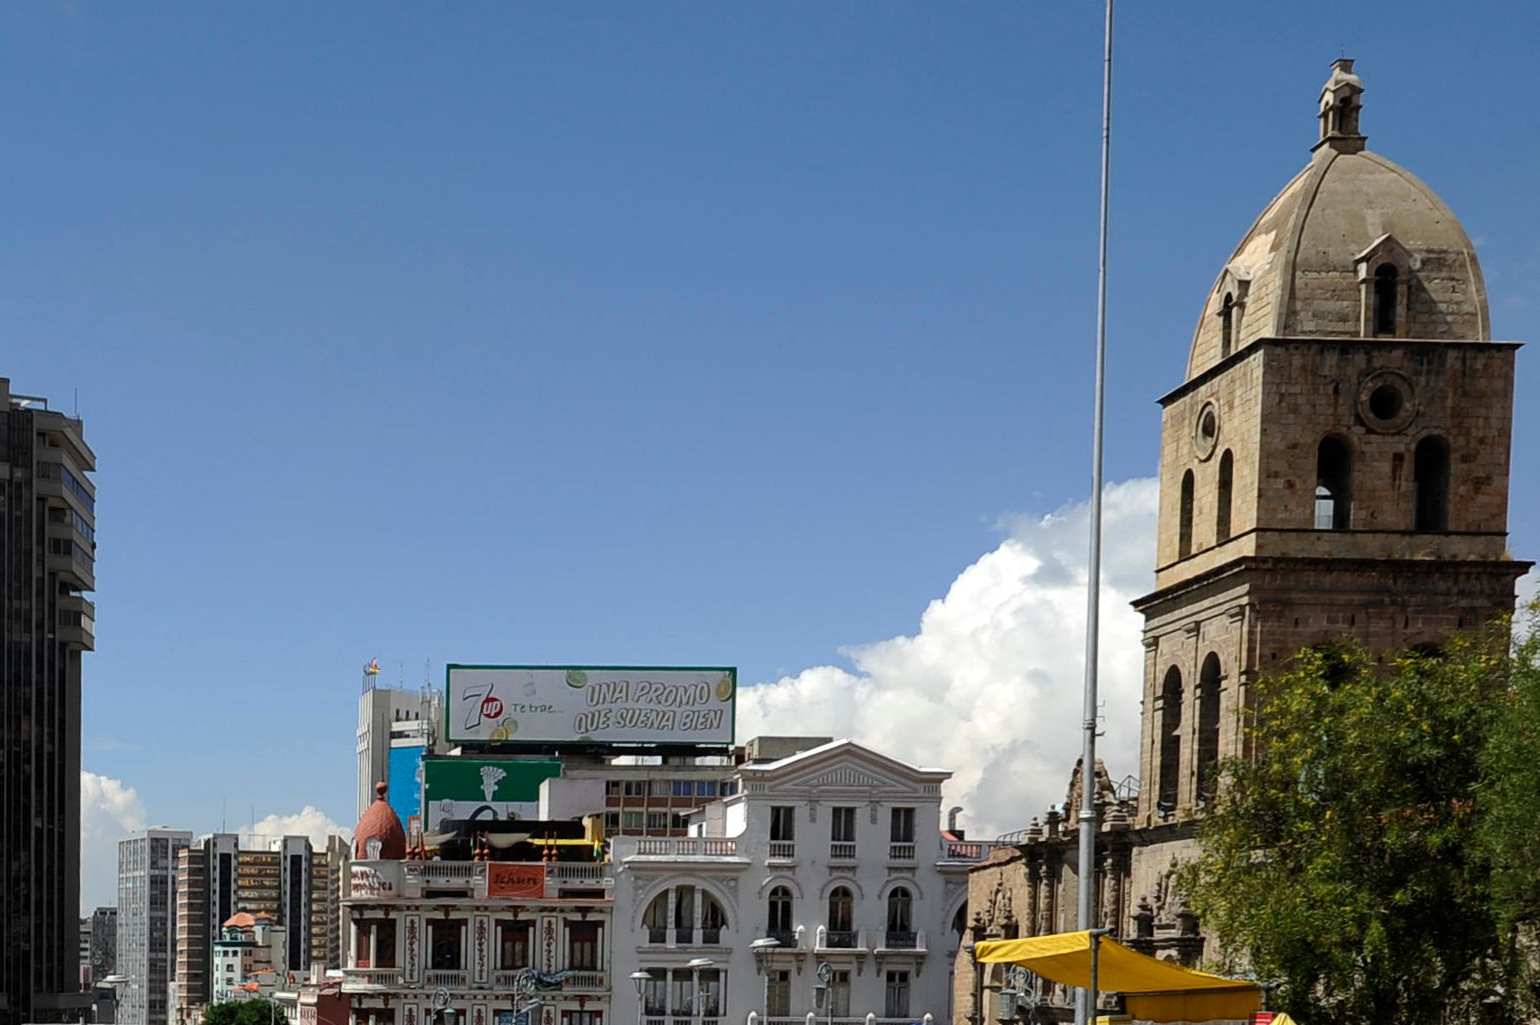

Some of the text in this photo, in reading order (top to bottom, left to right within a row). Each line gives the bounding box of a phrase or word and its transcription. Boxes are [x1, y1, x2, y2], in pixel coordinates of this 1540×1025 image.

[586, 680, 710, 707] UNA PROMO
[512, 703, 527, 713] Te
[574, 707, 724, 734] QUE SUENA BIEN
